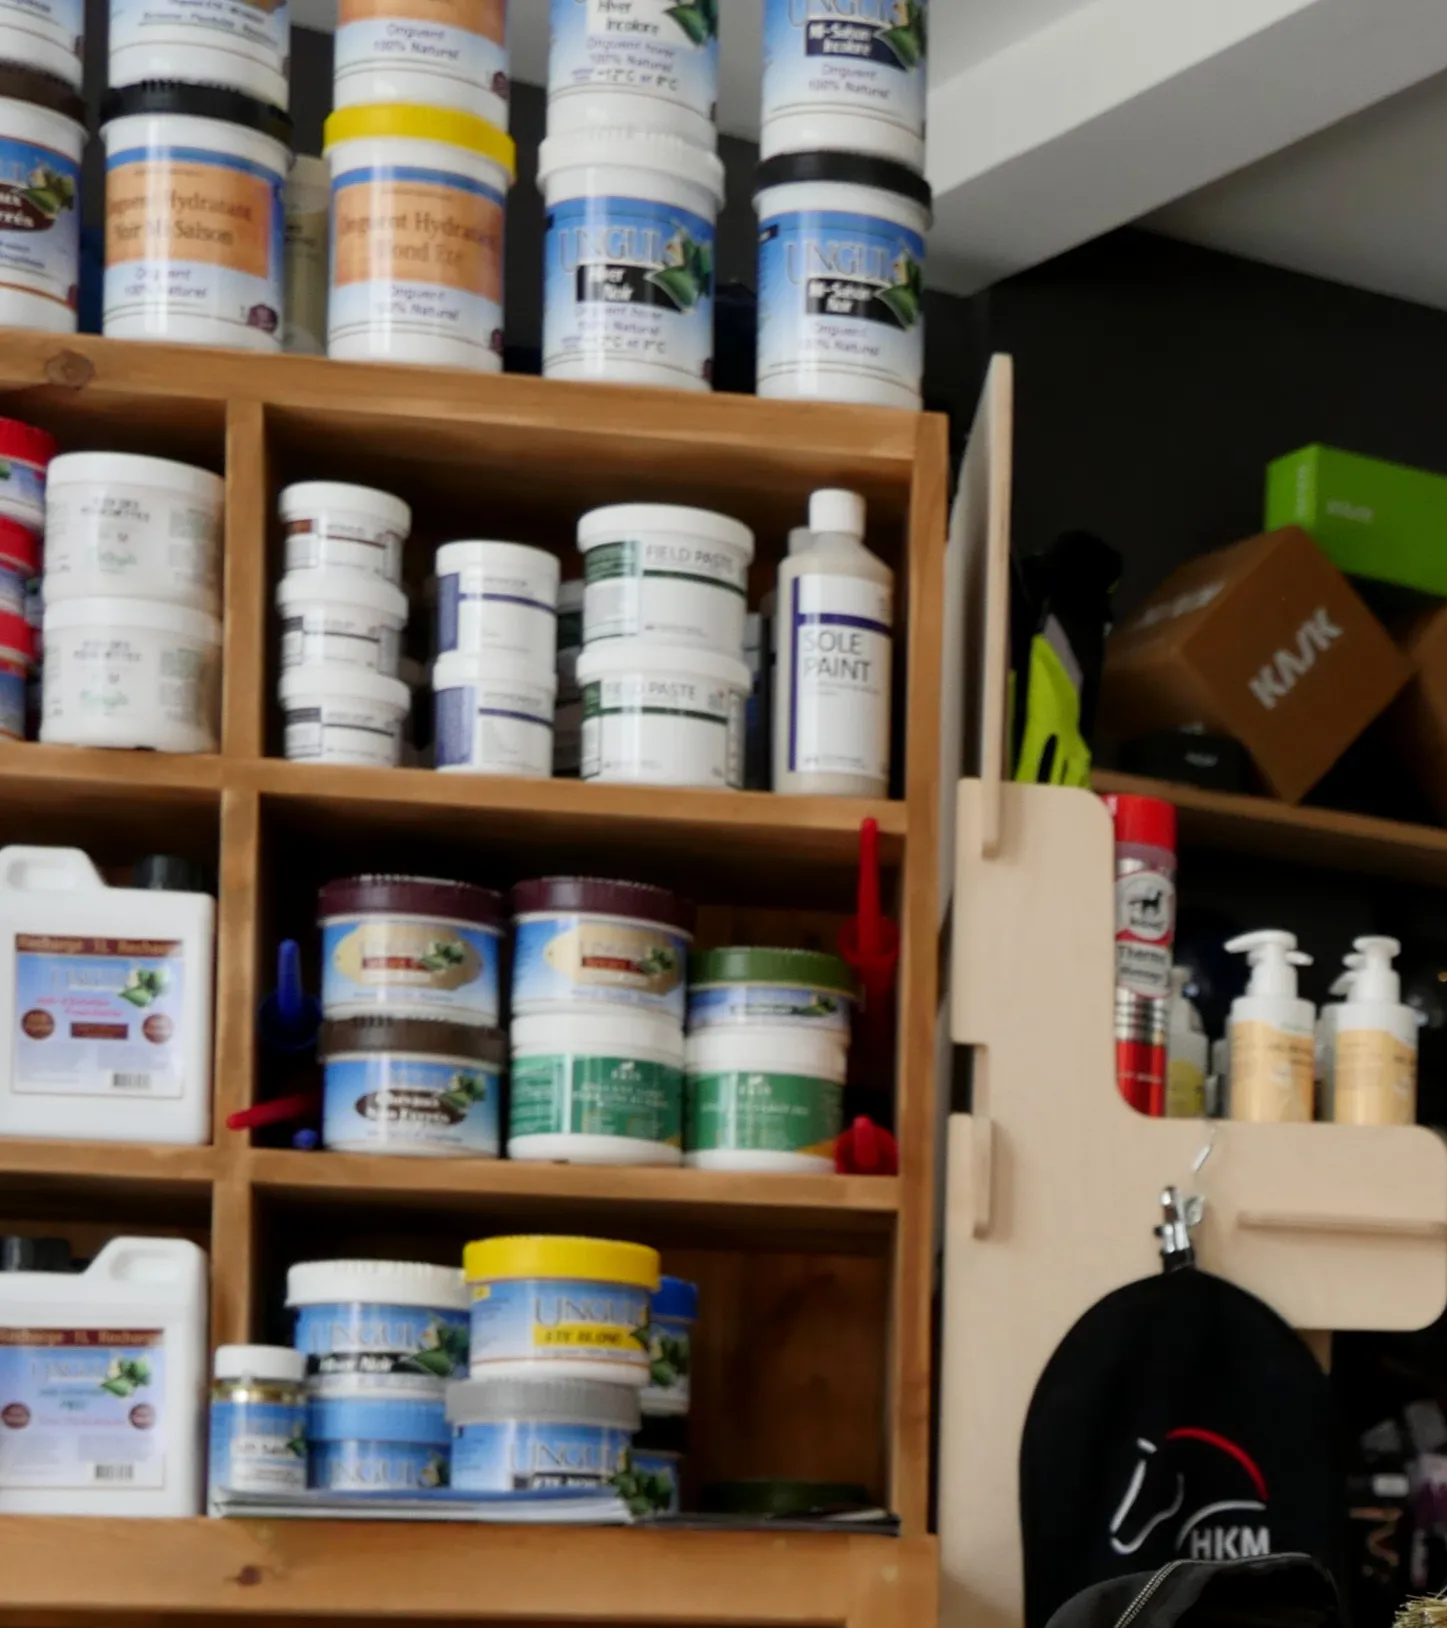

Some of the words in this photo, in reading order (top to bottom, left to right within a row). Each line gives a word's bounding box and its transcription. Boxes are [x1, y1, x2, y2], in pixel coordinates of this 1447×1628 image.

[802, 630, 863, 655] SOLE
[802, 656, 871, 682] PAINT
[1191, 1526, 1270, 1560] HKM
